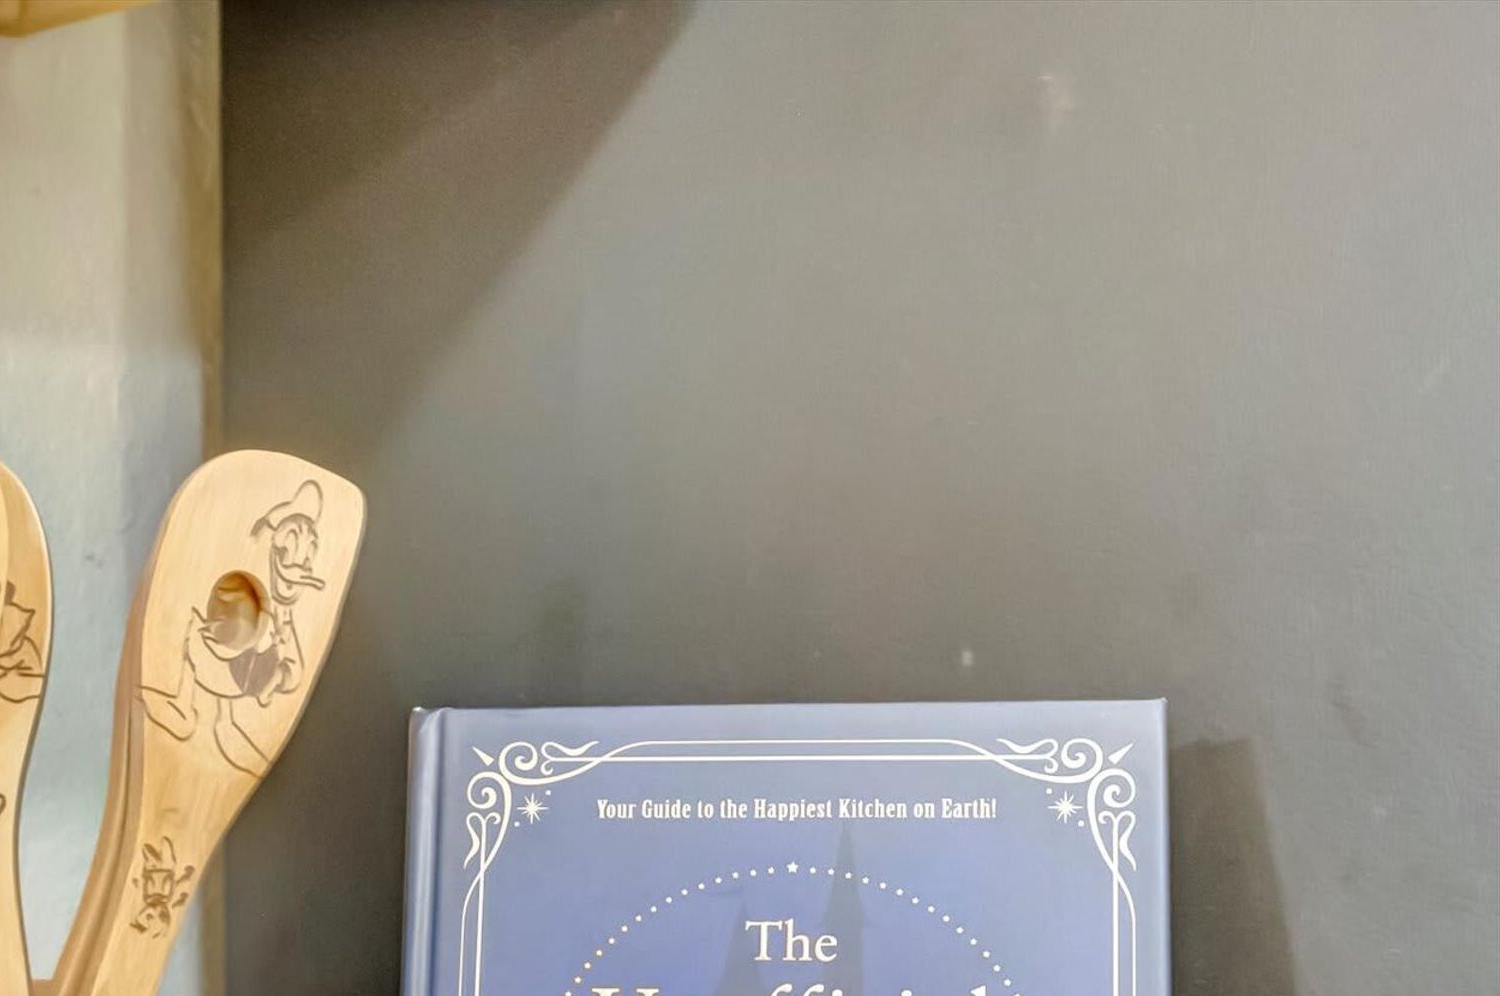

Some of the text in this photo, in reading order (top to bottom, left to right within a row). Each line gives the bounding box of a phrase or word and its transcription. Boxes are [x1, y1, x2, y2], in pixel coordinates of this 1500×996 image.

[597, 797, 997, 821] Your Guide to the Happiest Kitchen on Earth!
[745, 919, 838, 962] The
